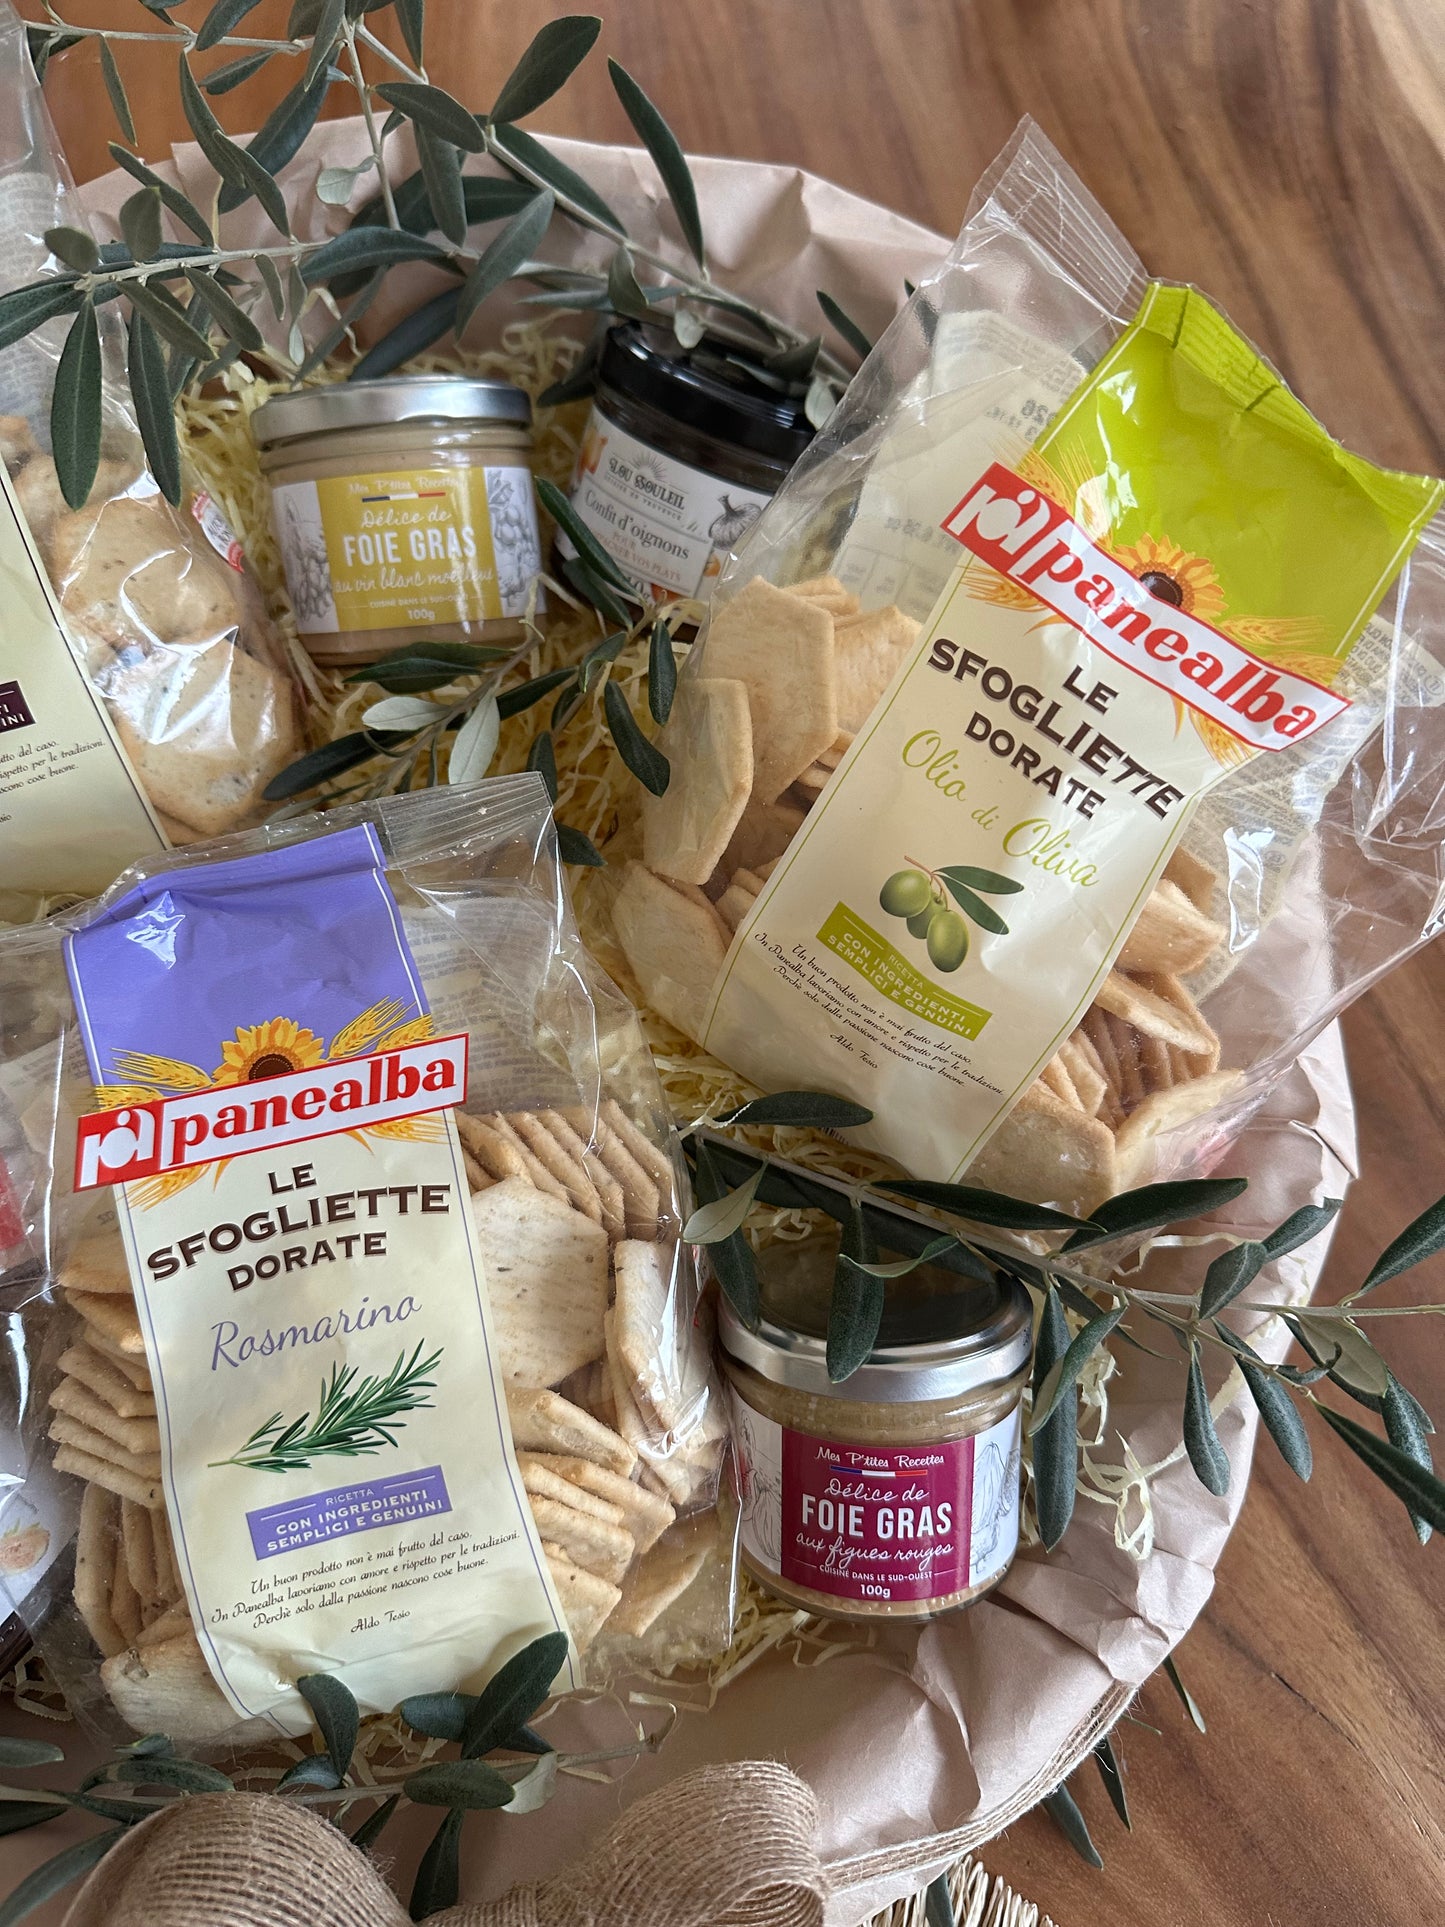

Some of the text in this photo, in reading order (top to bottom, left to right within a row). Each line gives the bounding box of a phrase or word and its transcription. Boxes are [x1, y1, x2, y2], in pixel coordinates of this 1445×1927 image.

[362, 504, 452, 527] Délice de
[585, 489, 689, 559] Confit d'oignons
[343, 526, 477, 567] FOIE GRAS
[334, 582, 351, 594] au
[355, 577, 377, 592] vin
[380, 567, 424, 590] blanc
[408, 608, 435, 622] 100g
[1016, 537, 1318, 739] panealba
[1062, 665, 1119, 715] LE
[19, 744, 32, 757] del
[36, 740, 60, 752] caso.
[926, 638, 1186, 822] SFOGLIETTE
[0, 739, 106, 779] ispetto per le tradizioni.
[0, 763, 79, 794] scono cose buone.
[964, 711, 1106, 821] DORATE
[902, 729, 1100, 887] Olio di Oliva
[827, 935, 972, 1036] SEMPLICI E GENUINI
[843, 932, 966, 1022] CON INGREDIENTI
[889, 955, 924, 989] RICETTA
[755, 932, 769, 947] In
[769, 944, 806, 979] Panealba
[807, 972, 845, 1008] lavoriamo
[847, 1007, 862, 1019] con
[864, 1016, 889, 1035] amore
[898, 1039, 931, 1057] rispetto
[933, 1054, 950, 1066] per
[951, 1061, 960, 1071] le
[961, 1068, 1004, 1095] tradizioni.
[773, 965, 965, 1087] Perchè solo dalla passione nascono cose buone.
[792, 943, 807, 962] Un
[807, 954, 827, 977] buon
[826, 973, 859, 1003] prodotto
[861, 1002, 877, 1015] non
[887, 1018, 904, 1032] mai
[904, 1029, 931, 1045] frutto
[934, 1038, 950, 1052] del
[951, 1050, 972, 1065] caso.
[830, 1033, 878, 1069] Aldo Tesio
[168, 1053, 457, 1167] panealba
[267, 1163, 317, 1195] LE
[146, 1184, 452, 1281] SFOGLIETTE
[227, 1231, 388, 1292] DORATE
[210, 1296, 423, 1371] Rosmarino
[815, 1446, 945, 1468] Mes P'tites Recettes
[275, 1489, 428, 1535] CON INGREDIENTI
[325, 1488, 375, 1506] RICETTA
[824, 1478, 929, 1502] Délice de
[266, 1499, 444, 1551] SEMPLICI E GENUINI
[802, 1494, 953, 1539] FOIE GRAS
[250, 1531, 472, 1595] Un buon prodotto non è mai frutto del caso.
[796, 1531, 954, 1571] aux figues rouges
[819, 1564, 933, 1582] CUISINÉ DANS LE SUD-OUEST
[211, 1530, 520, 1624] In Panealba lavoriamo con amore e rispetto per le tradizioni.
[253, 1559, 488, 1629] Perchè solo dalla passione nascono cose buone.
[860, 1584, 891, 1598] 100g
[350, 1609, 411, 1633] Aldo Tesio
